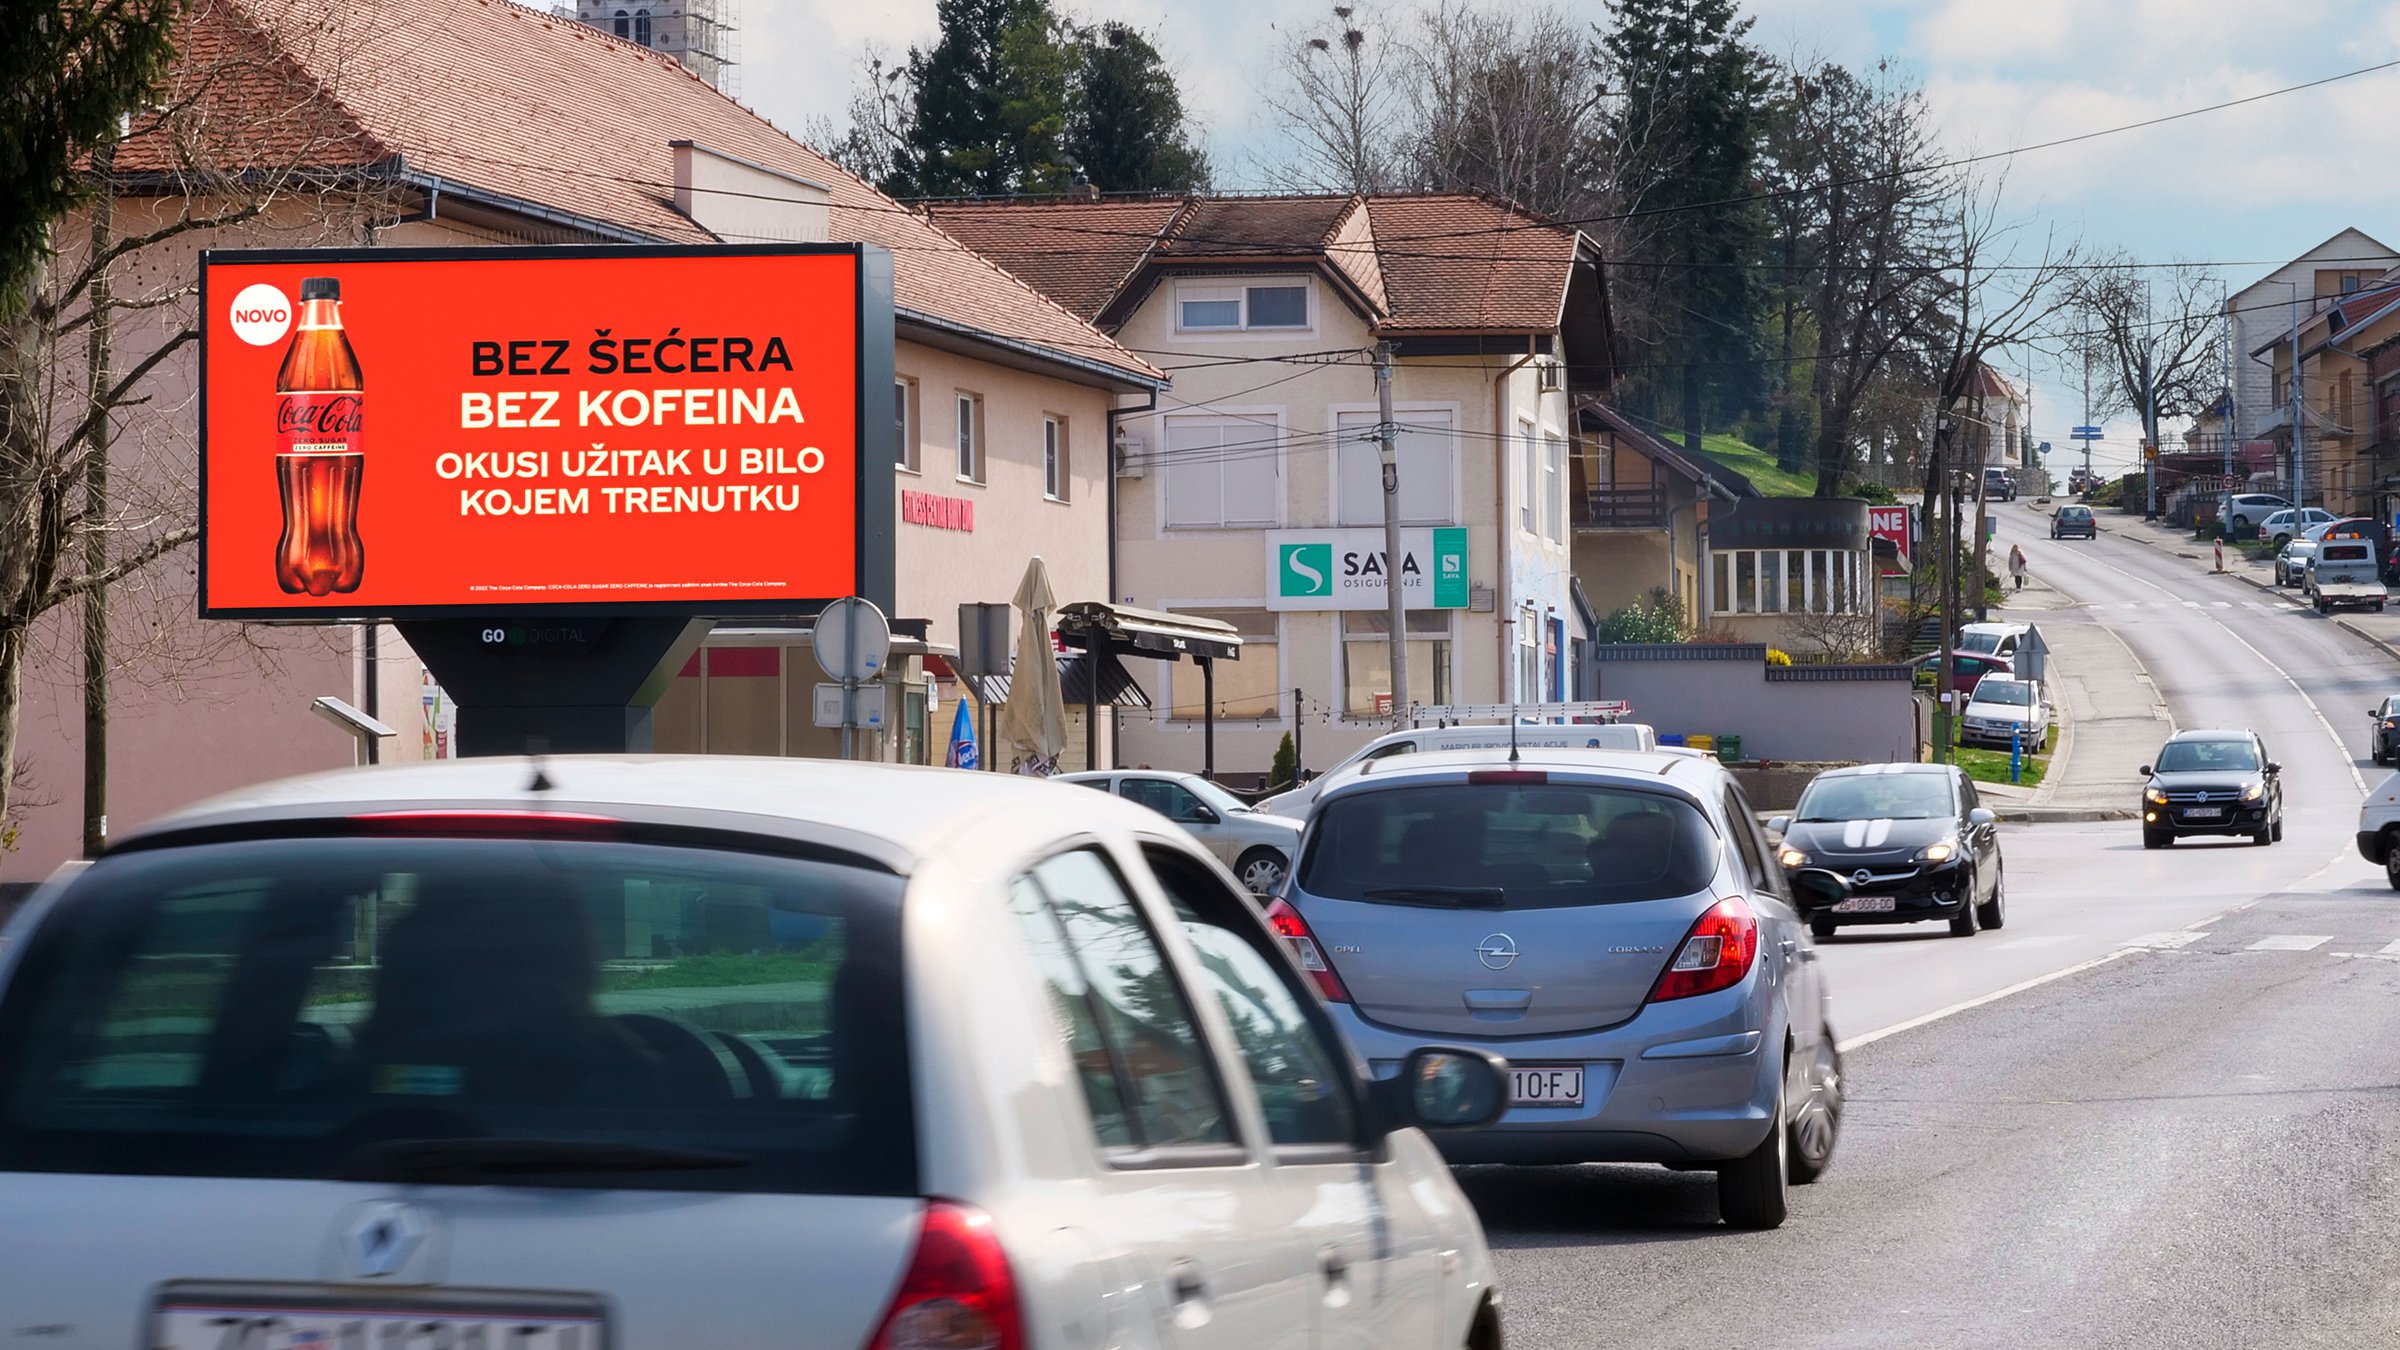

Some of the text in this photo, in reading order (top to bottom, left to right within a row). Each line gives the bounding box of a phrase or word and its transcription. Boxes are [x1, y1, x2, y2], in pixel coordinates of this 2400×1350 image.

[236, 309, 286, 323] NOVO
[473, 328, 793, 376] BEZ ŠEĆERA
[278, 396, 362, 433] Coca-Cola
[461, 388, 804, 428] BEZ KOFEINA
[435, 444, 824, 478] OKUSI UŽITAK U BILO
[461, 485, 800, 515] KOJEM TRENUTKU
[1344, 578, 1422, 588] OSIGURNJE
[482, 629, 505, 643] GO
